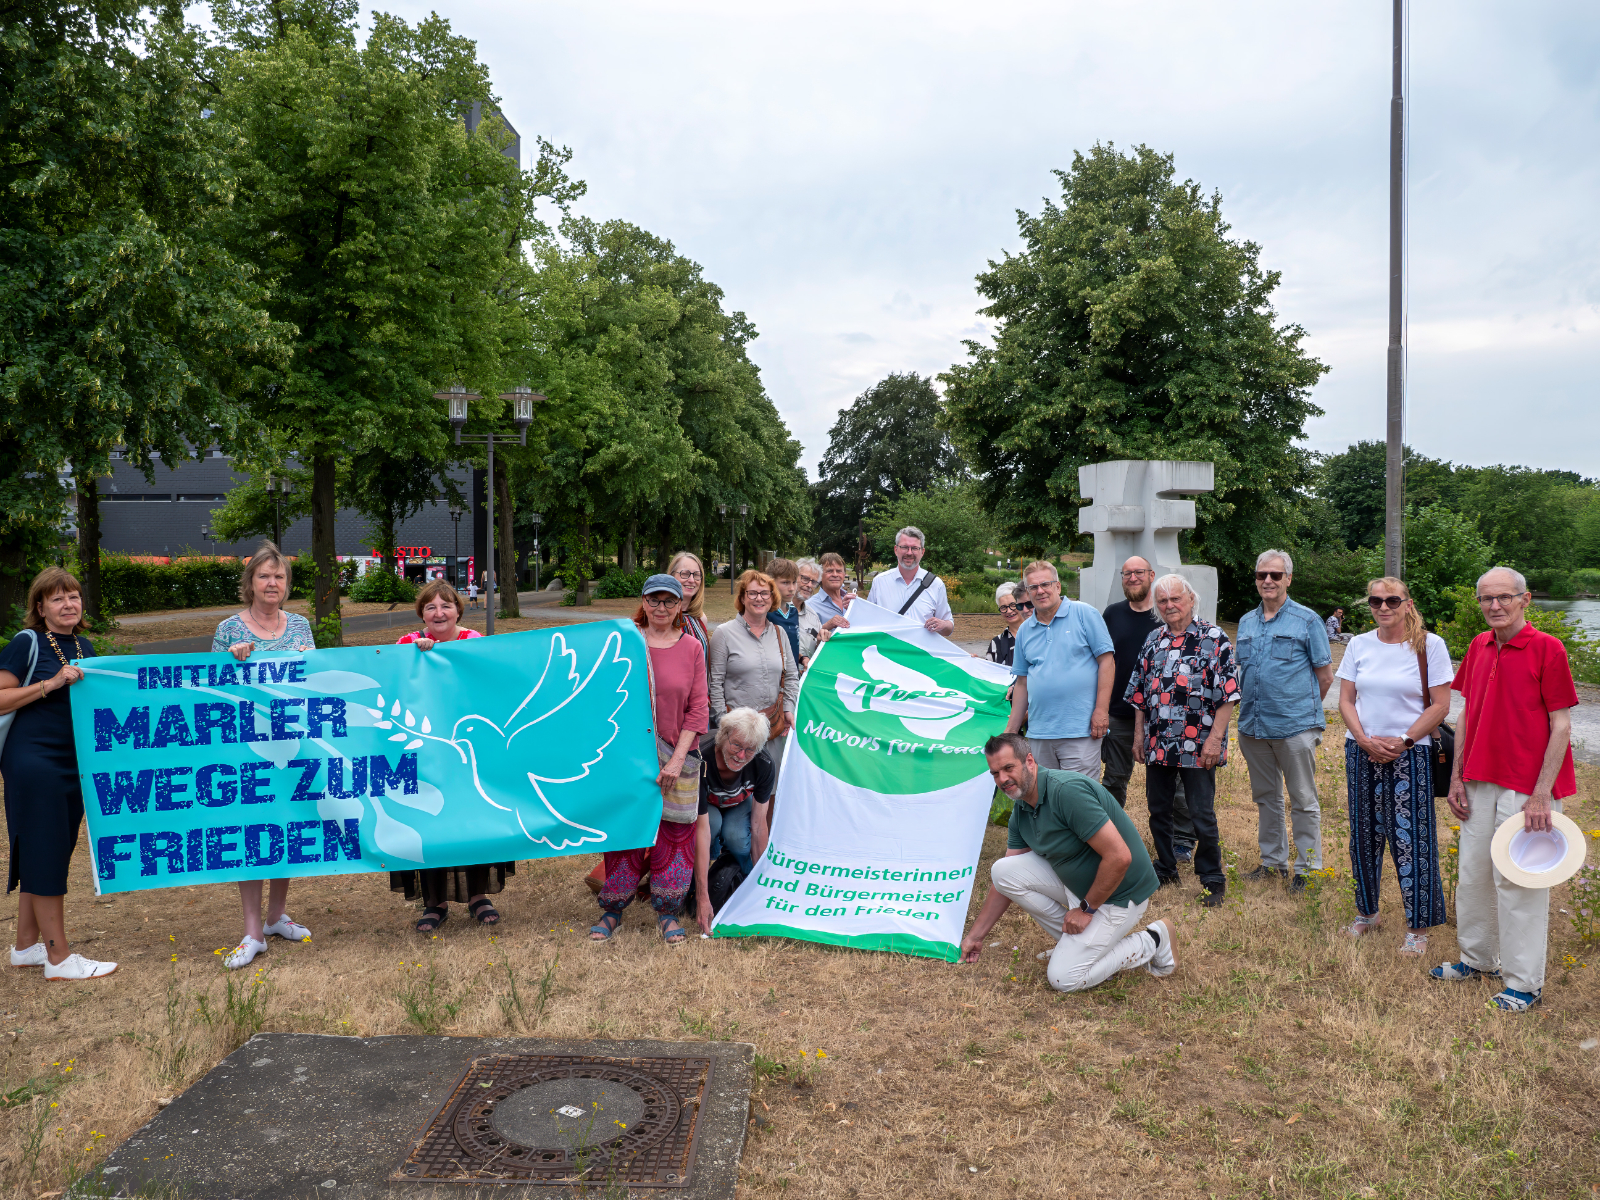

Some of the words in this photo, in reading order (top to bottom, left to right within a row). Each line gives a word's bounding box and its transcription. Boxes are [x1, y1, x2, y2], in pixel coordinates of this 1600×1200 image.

[372, 546, 432, 558] RSTO
[137, 661, 307, 690] INITIATIVE
[93, 697, 348, 753] MARLER
[803, 719, 882, 751] Mayors
[887, 739, 924, 756] for
[92, 760, 276, 816] WEGE
[288, 752, 419, 802] ZUM
[97, 818, 362, 881] FRIEDEN
[767, 842, 973, 882] Bürgermeisterinnen
[757, 873, 800, 893] und
[805, 882, 965, 903] Bürgermeister
[766, 896, 800, 913] für
[805, 905, 847, 917] den
[854, 905, 940, 921] Frieden
